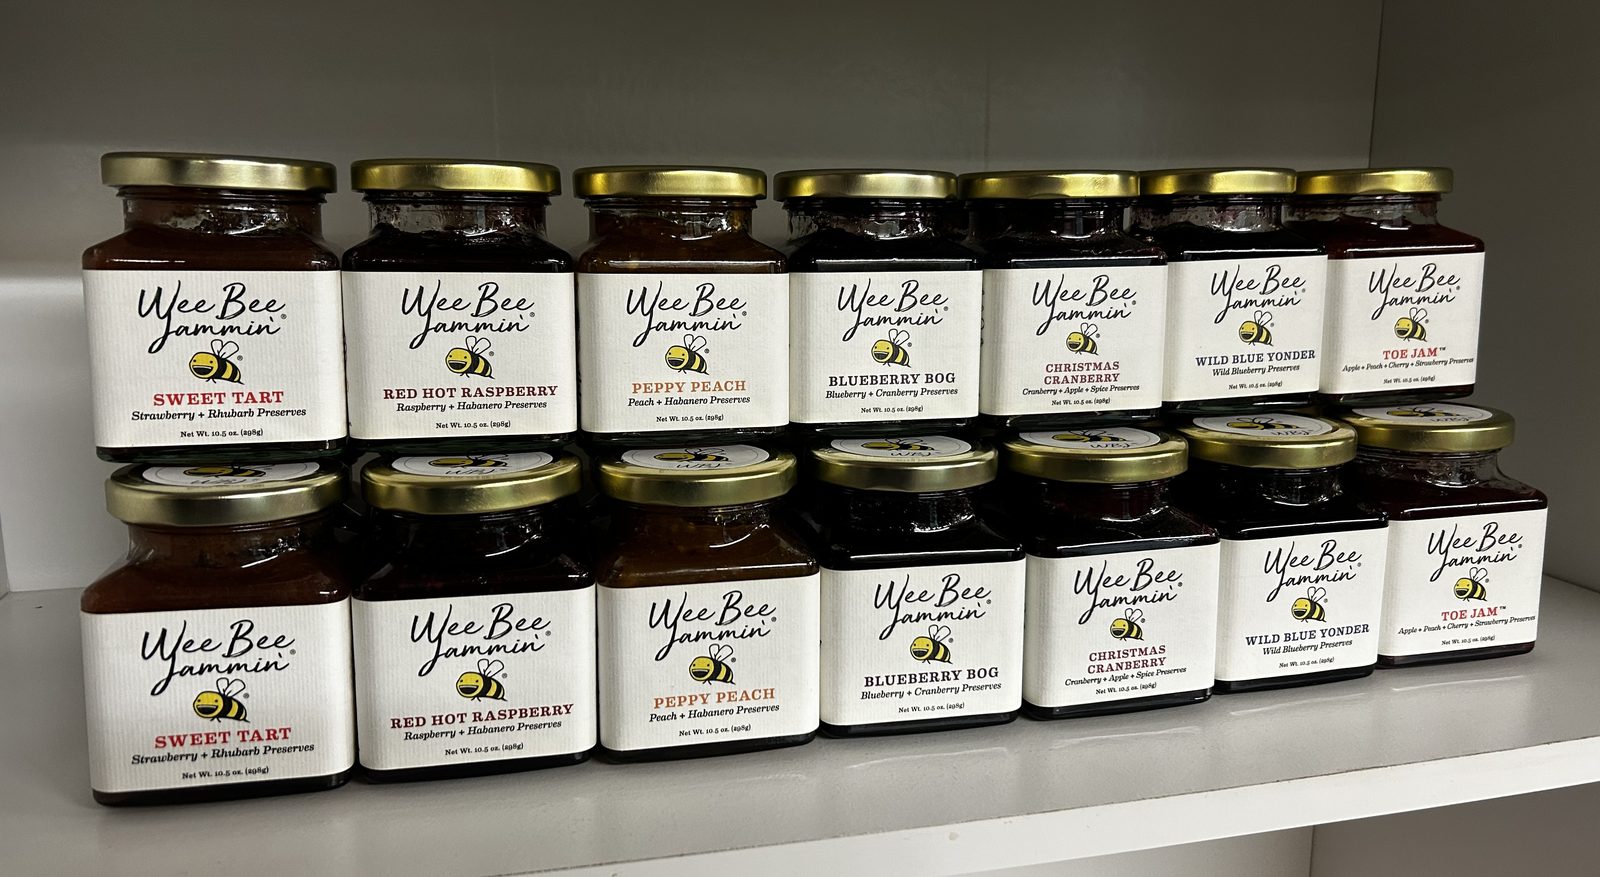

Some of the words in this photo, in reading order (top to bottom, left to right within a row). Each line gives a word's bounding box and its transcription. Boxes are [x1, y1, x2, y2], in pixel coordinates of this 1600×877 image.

[1211, 264, 1262, 296] Wee
[1259, 264, 1306, 295] Bee
[1369, 263, 1417, 293] Wee
[1415, 263, 1461, 294] Bee
[402, 280, 473, 317] Wee
[471, 282, 535, 318] Bee
[626, 280, 691, 316] Wee
[689, 283, 747, 317] Bee
[838, 278, 895, 312] Wee
[894, 280, 948, 313] Bee
[1032, 274, 1088, 306] Wee
[1085, 275, 1137, 307] Bee
[138, 280, 216, 319] Wee
[215, 282, 287, 320] Bee
[1195, 356, 1229, 366] WILD
[1232, 353, 1263, 364] BLUE
[1267, 350, 1315, 362] YONDER
[1383, 349, 1408, 360] TOE
[1046, 361, 1119, 373] CHRISTMAS
[1213, 368, 1230, 376] Wild
[1231, 367, 1266, 375] Blueberry
[1342, 364, 1360, 372] Apple
[1415, 359, 1448, 367] Strawberry
[632, 382, 686, 394] PEPPY
[691, 381, 746, 392] PEACH
[829, 374, 920, 386] BLUEBERRY
[925, 373, 955, 384] BOG
[1044, 373, 1120, 385] CRANBERRY
[154, 392, 226, 406] SWEET
[232, 391, 284, 404] TART
[383, 389, 417, 399] RED
[422, 388, 456, 398] HOT
[461, 386, 558, 398] RASPBERRY
[825, 390, 866, 399] Blueberry
[876, 389, 918, 397] Cranberry
[1064, 386, 1084, 395] Apple
[1090, 385, 1108, 393] Spice
[396, 403, 446, 413] Raspberry
[457, 401, 502, 410] Habanero
[504, 401, 547, 409] Preserves
[628, 398, 654, 406] Peach
[664, 397, 708, 405] Habanero
[709, 396, 750, 404] Preserves
[131, 410, 195, 421] Strawberry
[207, 408, 254, 418] Rhubarb
[257, 408, 306, 417] Preserves
[241, 428, 263, 437] (298g)
[1428, 523, 1479, 555] Wee
[1475, 522, 1523, 553] Bee
[1264, 541, 1316, 574] Wee
[1313, 539, 1362, 572] Bee
[1074, 560, 1132, 595] Wee
[1129, 558, 1183, 592] Bee
[874, 573, 935, 609] Wee
[934, 573, 991, 609] Bee
[649, 591, 717, 629] Wee
[714, 590, 777, 627] Bee
[1441, 610, 1467, 621] TOE
[411, 604, 485, 643] Wee
[483, 603, 551, 642] Bee
[1398, 627, 1417, 635] Apple
[141, 620, 222, 660] Wee
[221, 619, 296, 659] Bee
[1246, 634, 1280, 645] WILD
[1284, 630, 1316, 642] BLUE
[1320, 624, 1369, 638] YONDER
[1089, 645, 1166, 662] CHRISTMAS
[1263, 646, 1281, 655] Wild
[1282, 644, 1317, 653] Blueberry
[1320, 640, 1352, 649] Preserves
[1088, 657, 1166, 674] CRANBERRY
[864, 670, 962, 687] BLUEBERRY
[966, 667, 998, 679] BOG
[1065, 678, 1102, 686] Cranberry
[1108, 673, 1129, 682] Apple
[1136, 671, 1154, 679] Spice
[1156, 668, 1186, 676] Preserves
[654, 693, 711, 709] PEPPY
[716, 688, 775, 703] PEACH
[860, 690, 904, 700] Blueberry
[915, 686, 960, 696] Cranberry
[962, 683, 1001, 692] Preserves
[390, 716, 426, 728] RED
[431, 712, 467, 726] HOT
[471, 704, 574, 722] RASPBERRY
[649, 712, 677, 722] Peach
[688, 709, 734, 719] Habanero
[736, 705, 779, 714] Preserves
[155, 731, 231, 750] SWEET
[237, 727, 291, 743] TART
[404, 729, 456, 741] Raspberry
[467, 725, 515, 735] Habanero
[516, 721, 562, 731] Preserves
[131, 752, 198, 765] Strawberry
[210, 746, 260, 760] Rhubarb
[262, 744, 314, 756] Preserves
[502, 742, 523, 751] (298g)
